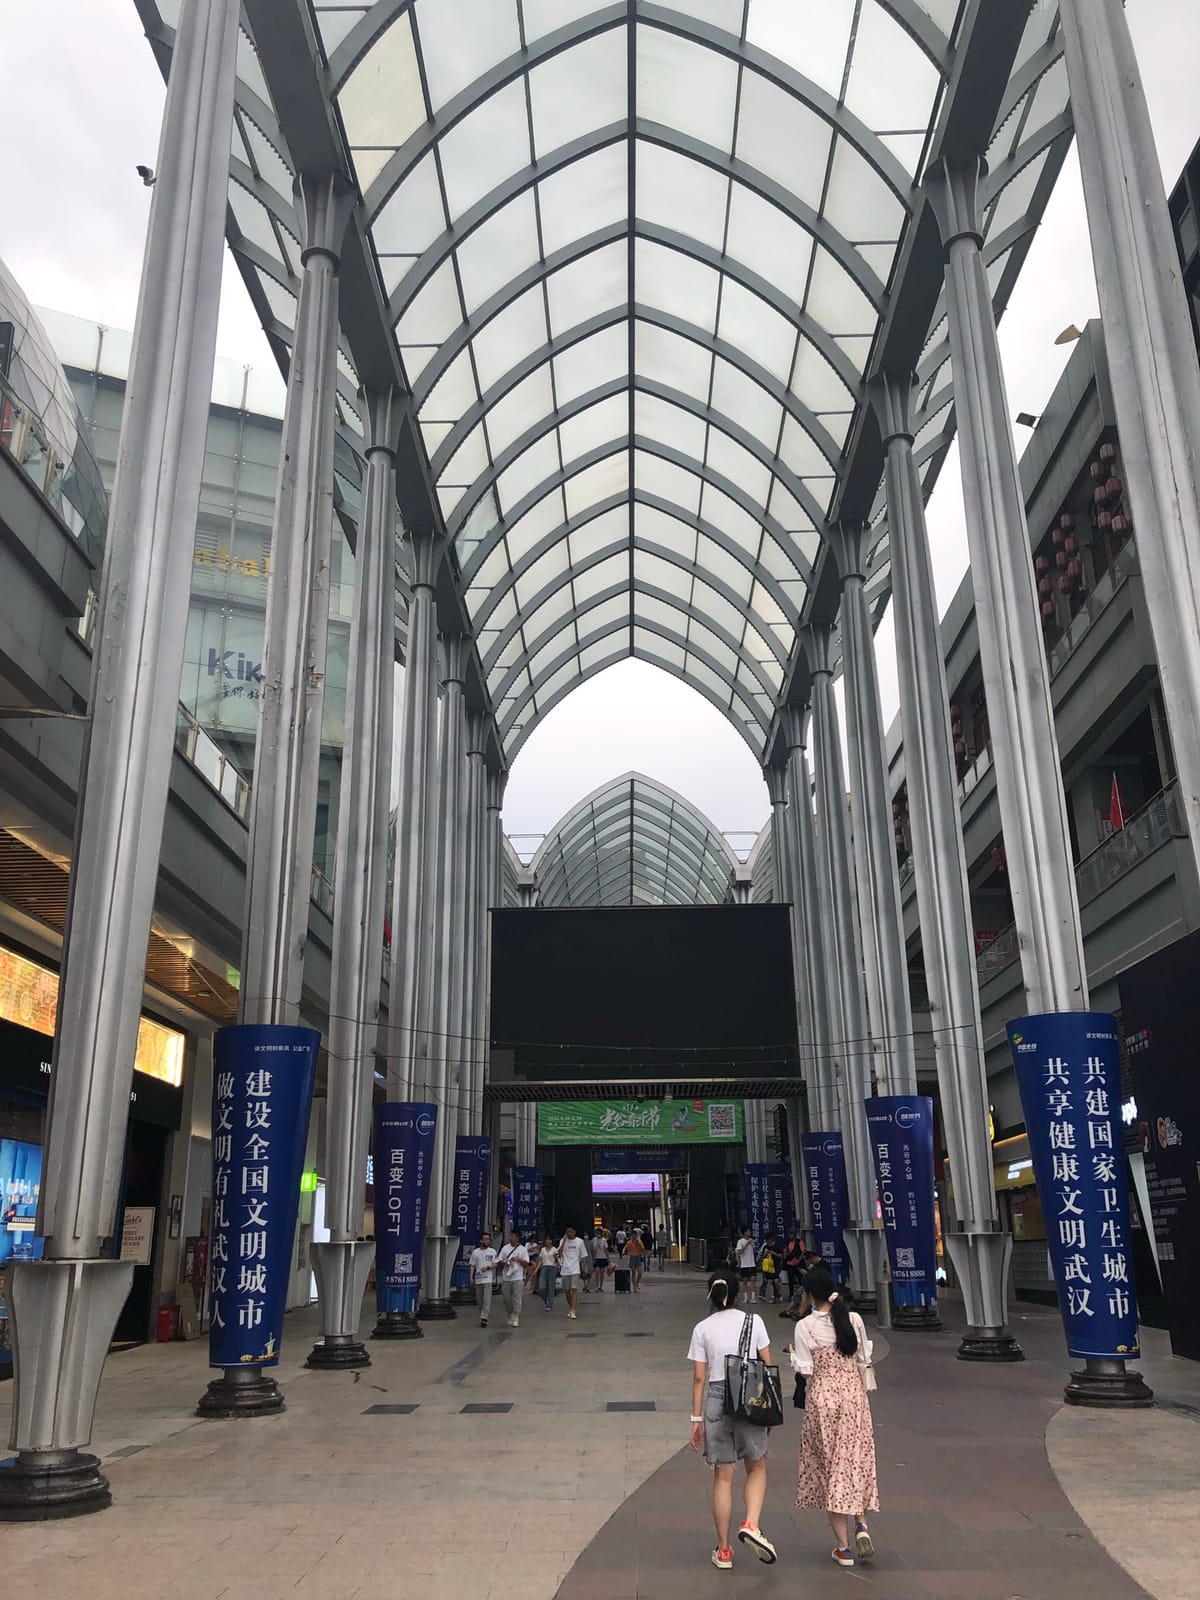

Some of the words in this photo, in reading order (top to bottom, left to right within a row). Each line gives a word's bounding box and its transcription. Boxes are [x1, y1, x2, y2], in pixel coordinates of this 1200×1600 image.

[210, 1071, 236, 1330] 做文明有礼武汉人
[237, 1069, 273, 1330] 建设全国文明城市
[387, 1149, 406, 1236] 百变LOFT
[457, 1169, 471, 1232] 百变LOFT
[876, 1143, 897, 1231] 百变LOFT
[1042, 1056, 1095, 1317] 共享健康文明武汉
[1082, 1056, 1131, 1320] 共建国家卫生城市
